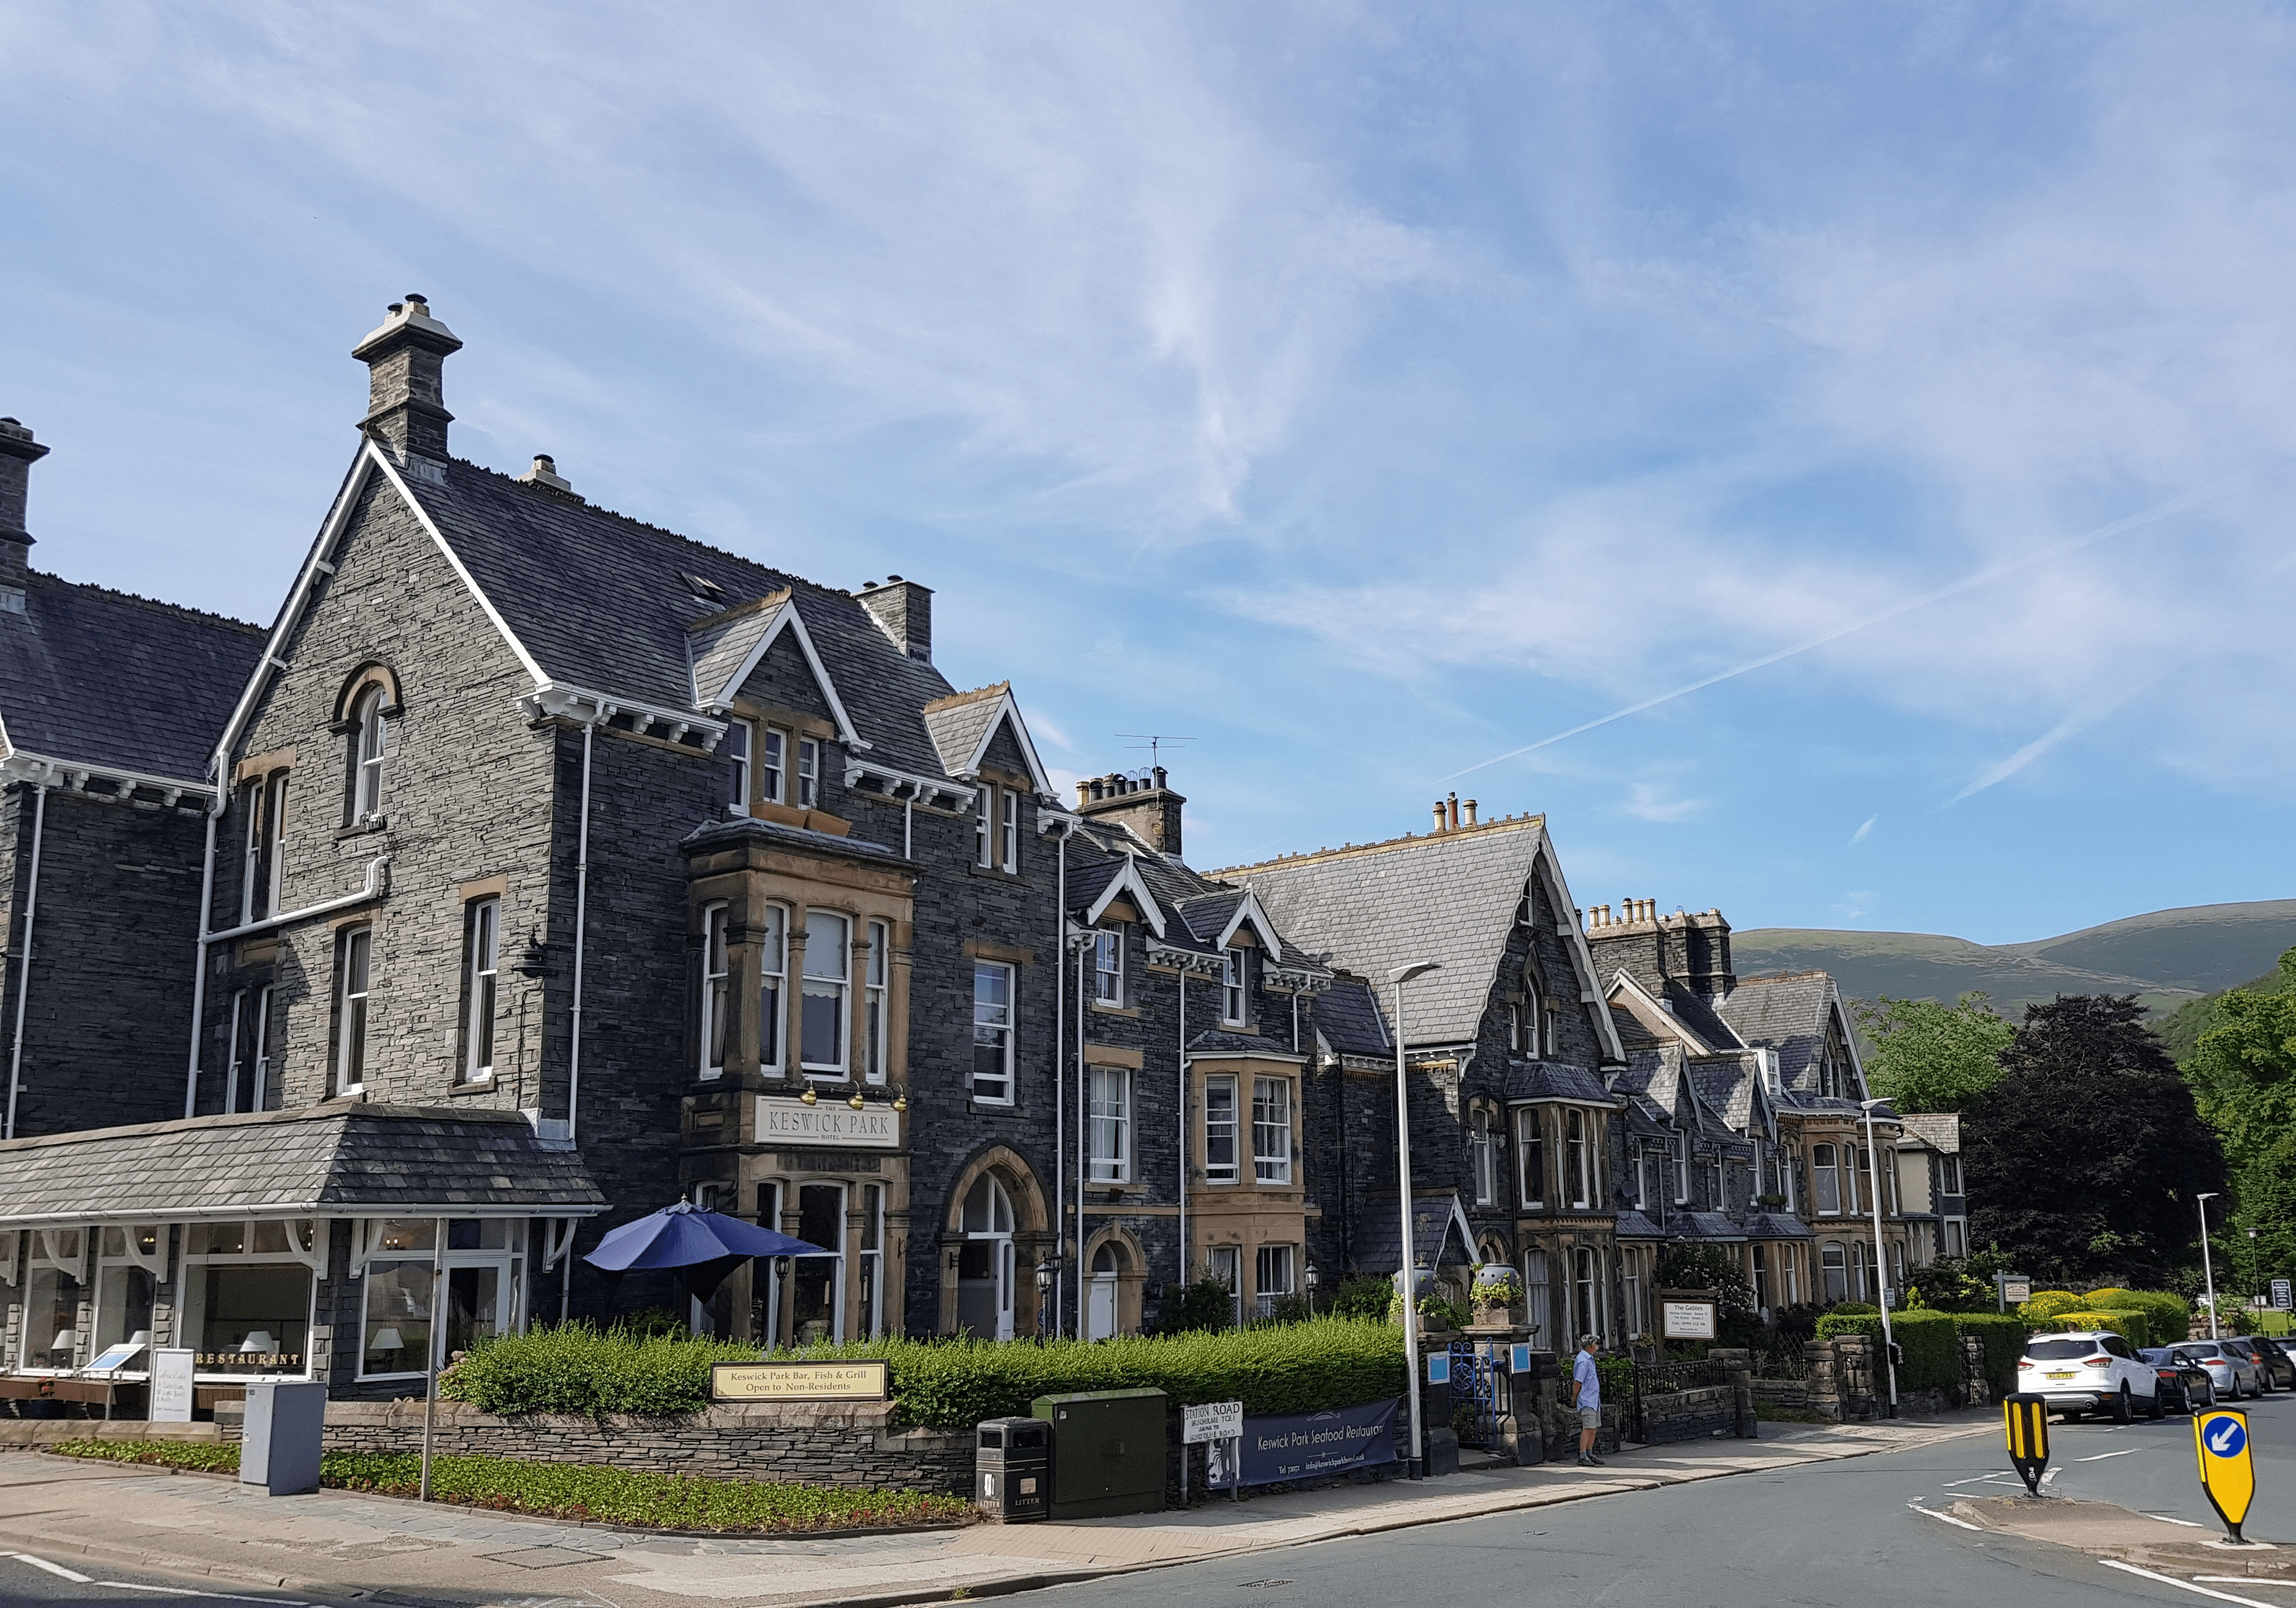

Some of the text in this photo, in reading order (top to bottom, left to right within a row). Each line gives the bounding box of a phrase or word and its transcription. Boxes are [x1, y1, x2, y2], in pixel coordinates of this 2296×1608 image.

[770, 1112, 888, 1134] KESWICK PARK
[195, 1353, 299, 1365] RESTAURANT
[731, 1372, 767, 1381] Keswick
[770, 1371, 790, 1380] Park
[793, 1372, 810, 1380] Bar,
[846, 1370, 866, 1379] Grill
[746, 1383, 770, 1393] Open
[786, 1382, 851, 1391] Non-Residents
[1186, 1403, 1240, 1420] STATION ROAD
[1258, 1424, 1385, 1451] Keswick Park Seafood Restauran
